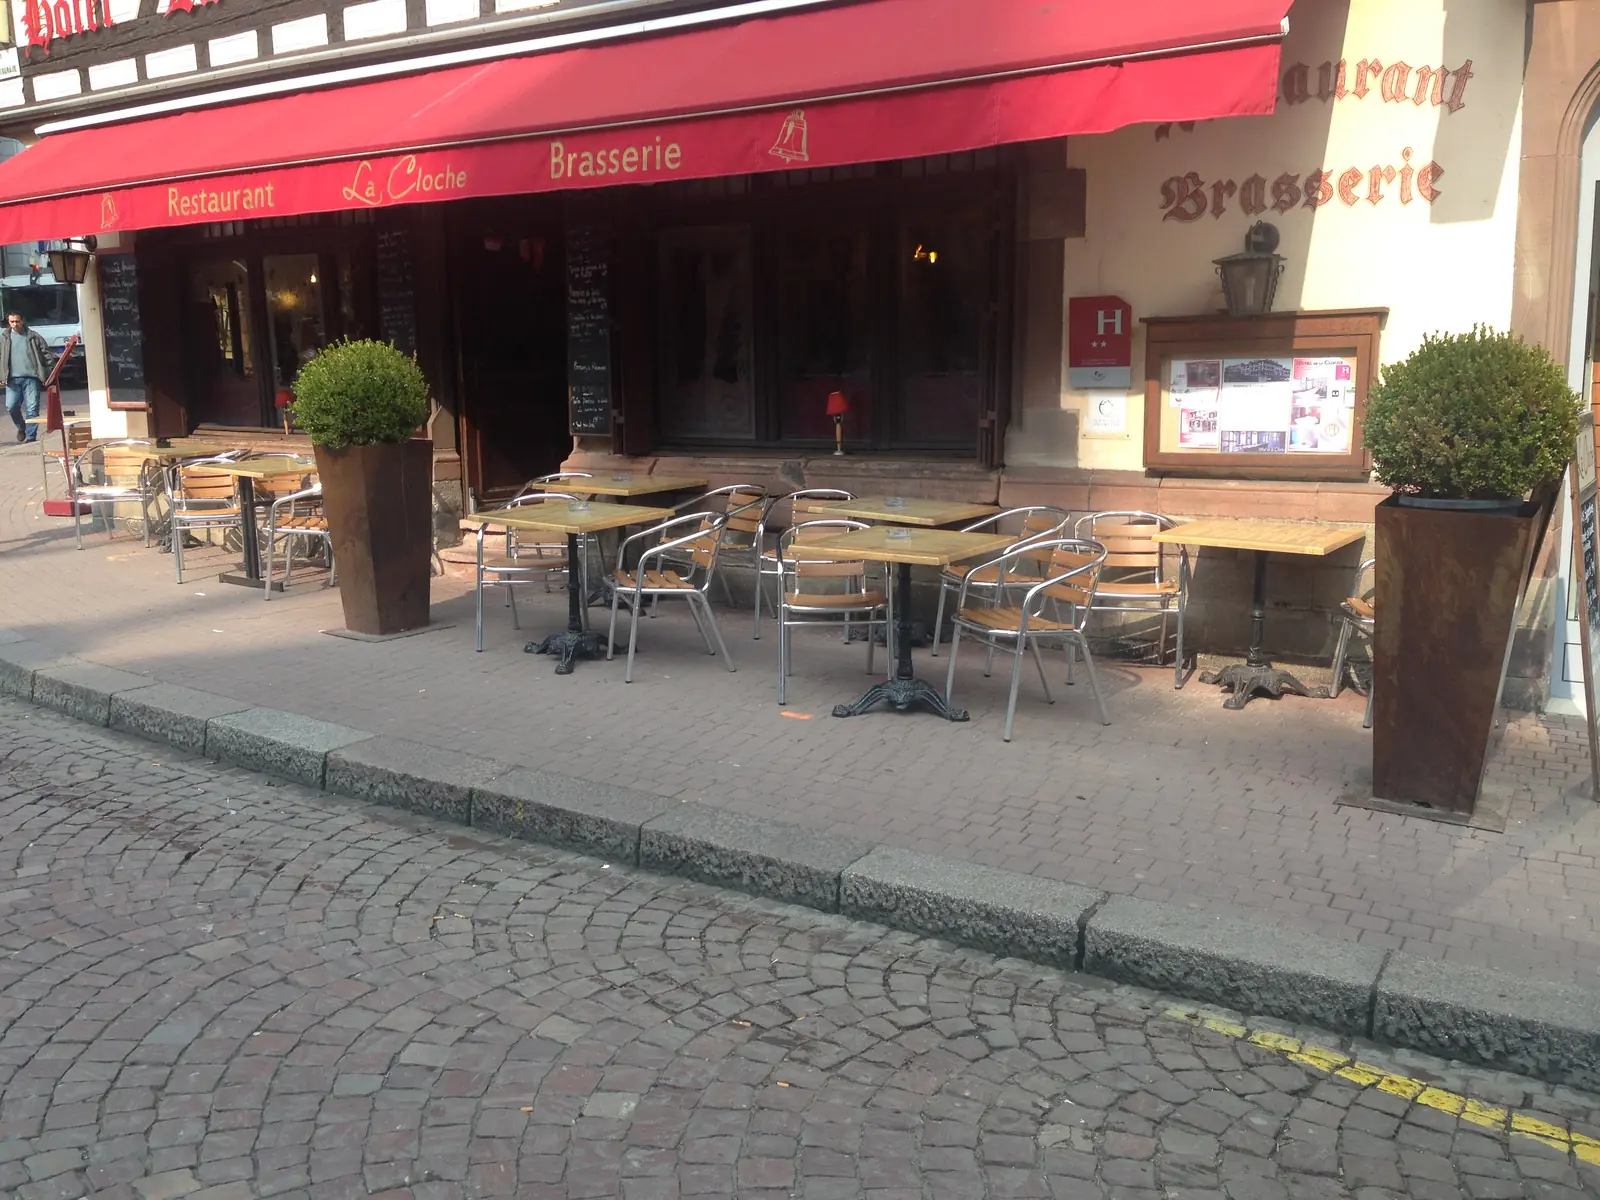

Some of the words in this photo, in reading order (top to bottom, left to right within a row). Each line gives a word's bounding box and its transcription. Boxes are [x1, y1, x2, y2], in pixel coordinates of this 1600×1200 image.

[342, 160, 382, 205] La
[387, 154, 467, 200] Cloche
[549, 136, 682, 180] Brasserie
[167, 181, 275, 217] Restaurant
[1159, 146, 1446, 223] Brasserie
[1096, 309, 1123, 336] H
